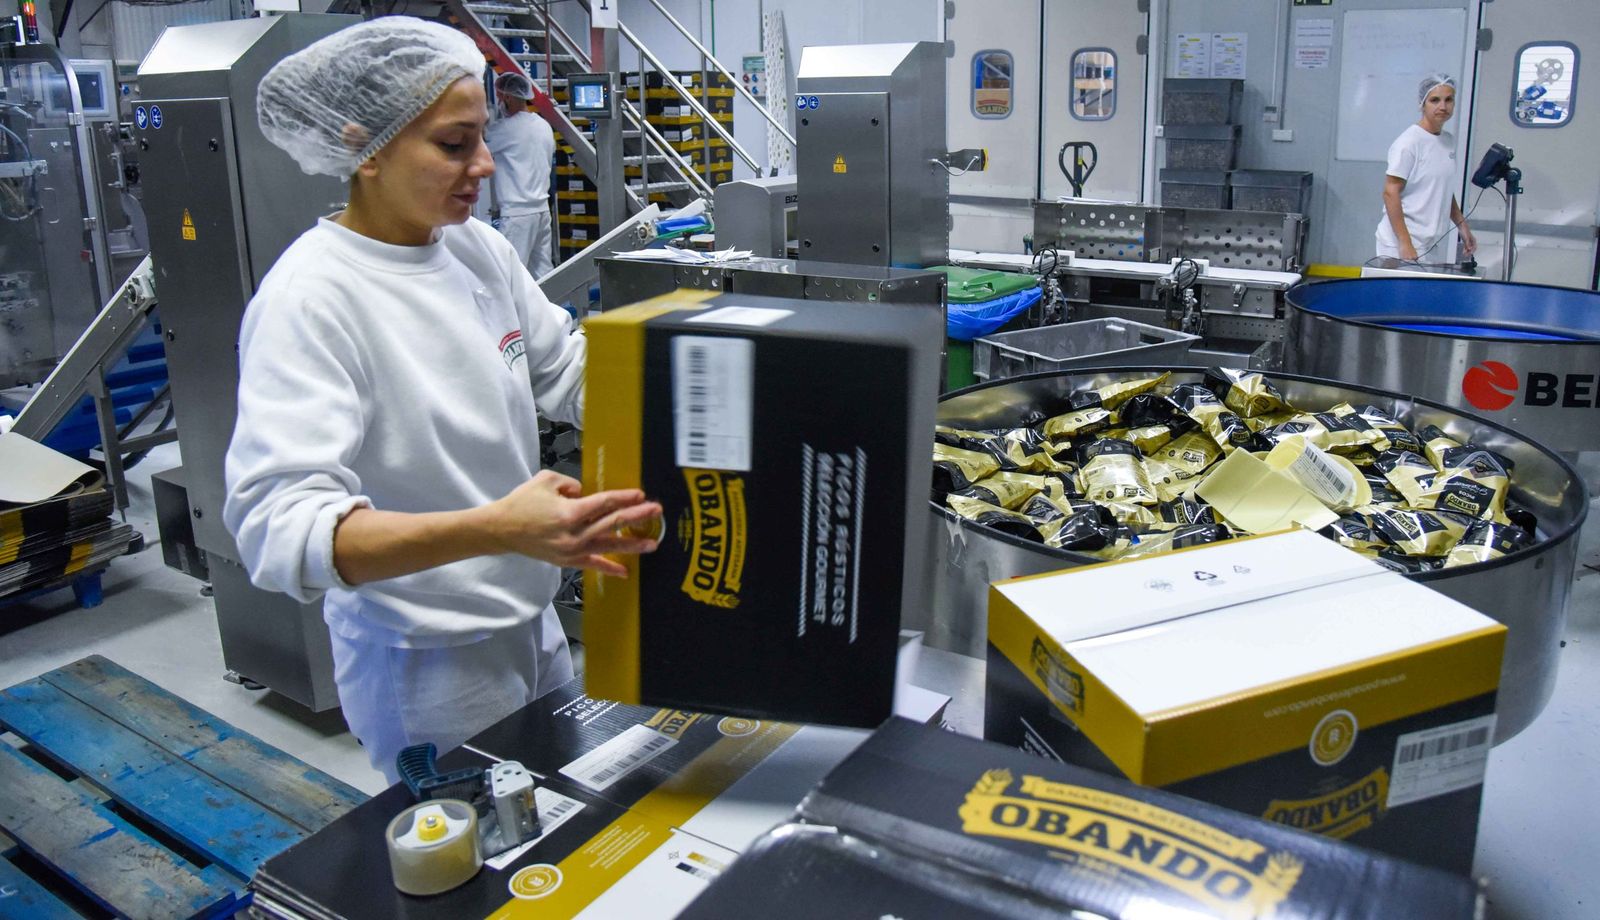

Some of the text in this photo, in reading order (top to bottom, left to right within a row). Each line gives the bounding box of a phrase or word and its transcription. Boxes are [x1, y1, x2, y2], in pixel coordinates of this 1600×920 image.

[1524, 372, 1600, 408] BE
[835, 453, 853, 519] PICOS
[693, 472, 723, 592] OBANDO
[814, 545, 829, 624] GOURMET
[575, 699, 611, 720] SELEC
[990, 803, 1252, 900] OBANDO
